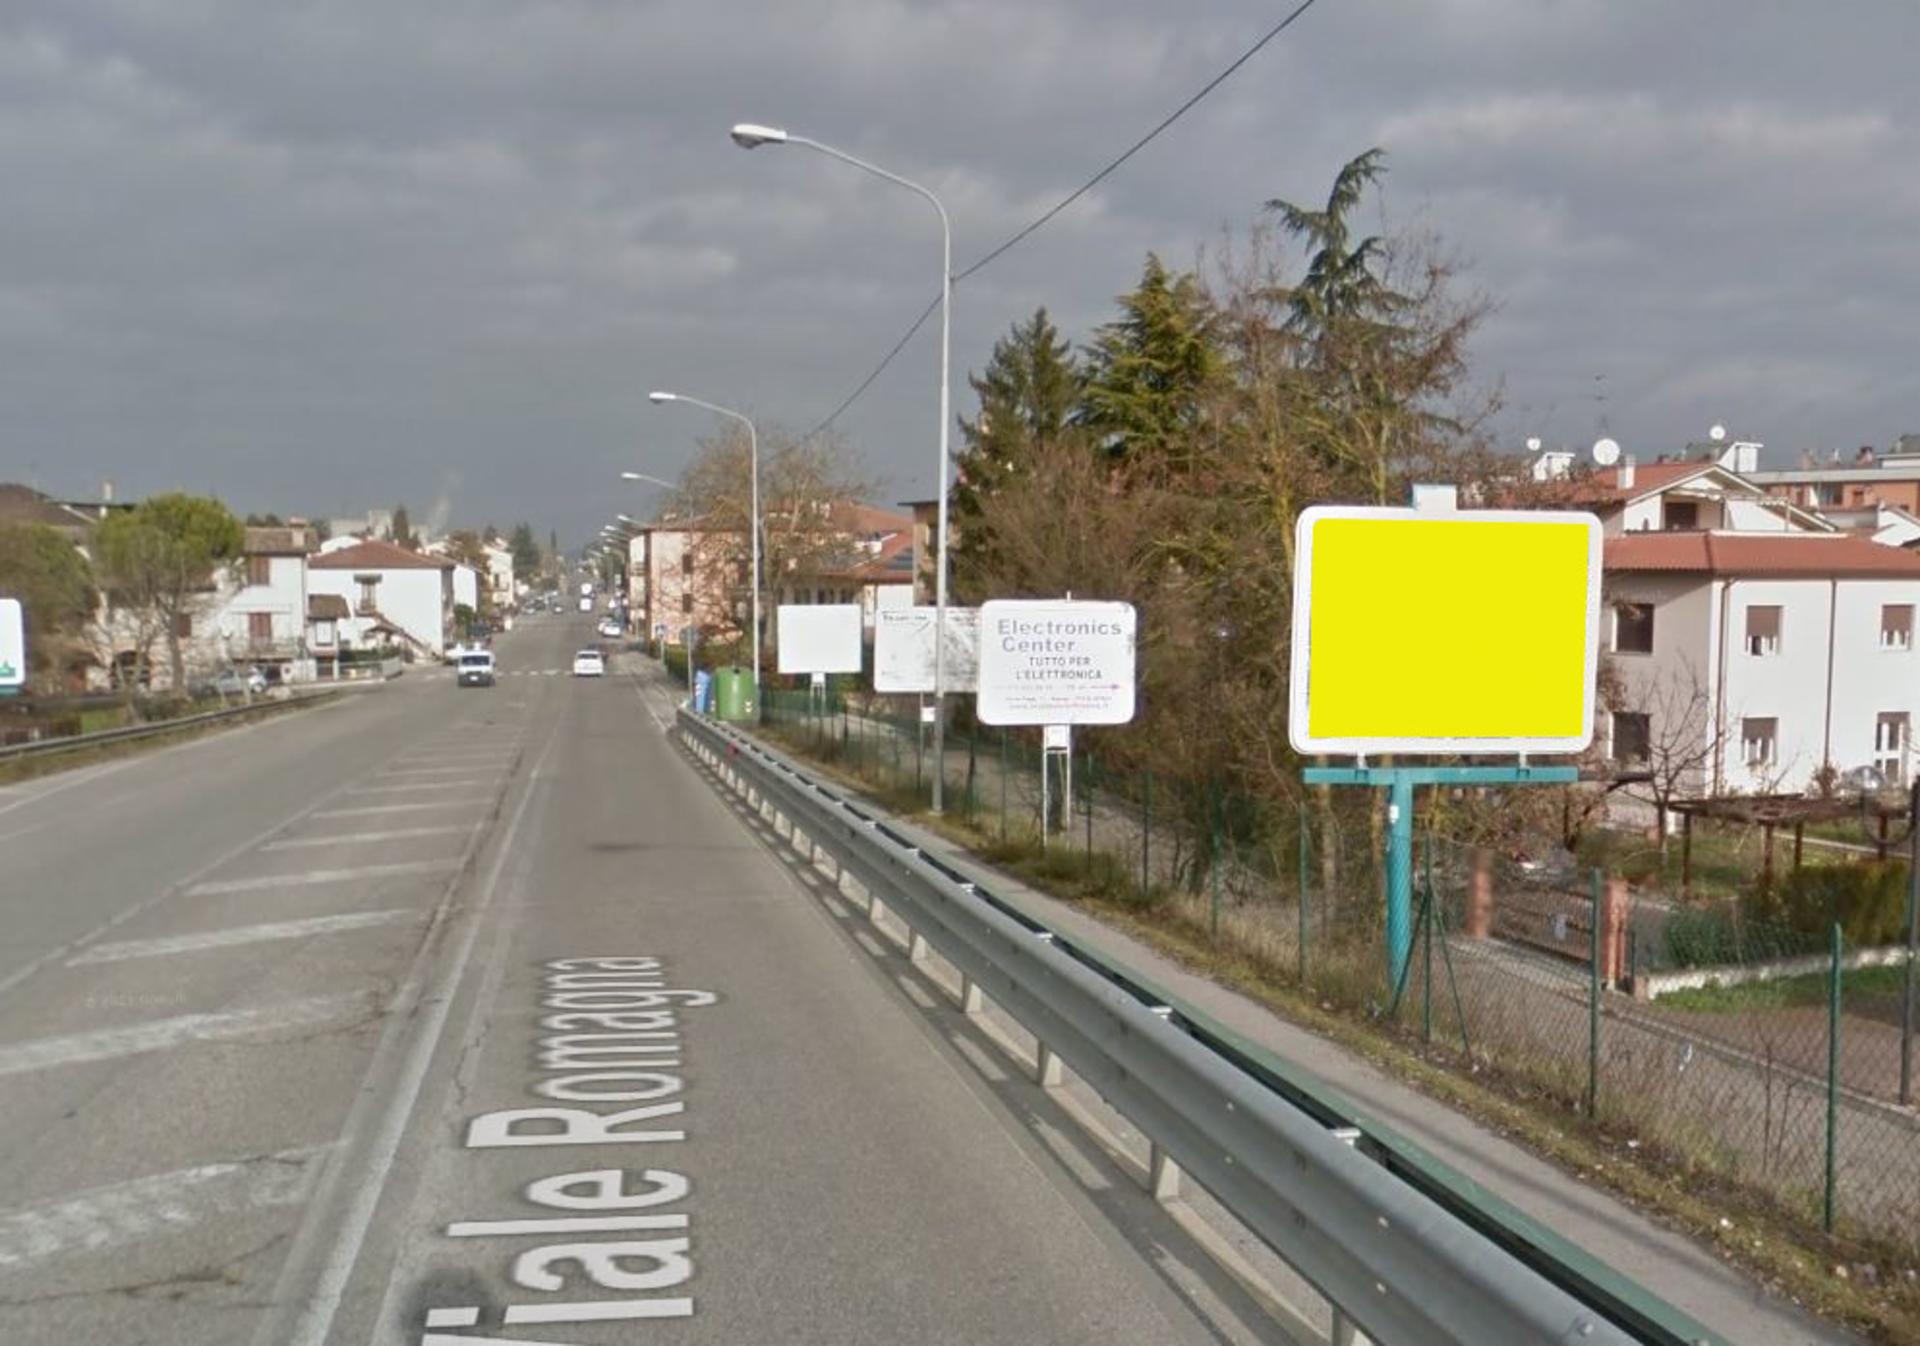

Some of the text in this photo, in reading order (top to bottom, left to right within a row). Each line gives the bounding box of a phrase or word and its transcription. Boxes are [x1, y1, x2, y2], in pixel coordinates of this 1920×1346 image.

[998, 618, 1122, 636] Electronics
[1002, 636, 1076, 653] Center
[1029, 656, 1091, 667] TUTTO PER
[1016, 669, 1102, 681] L'ELETTRONICA
